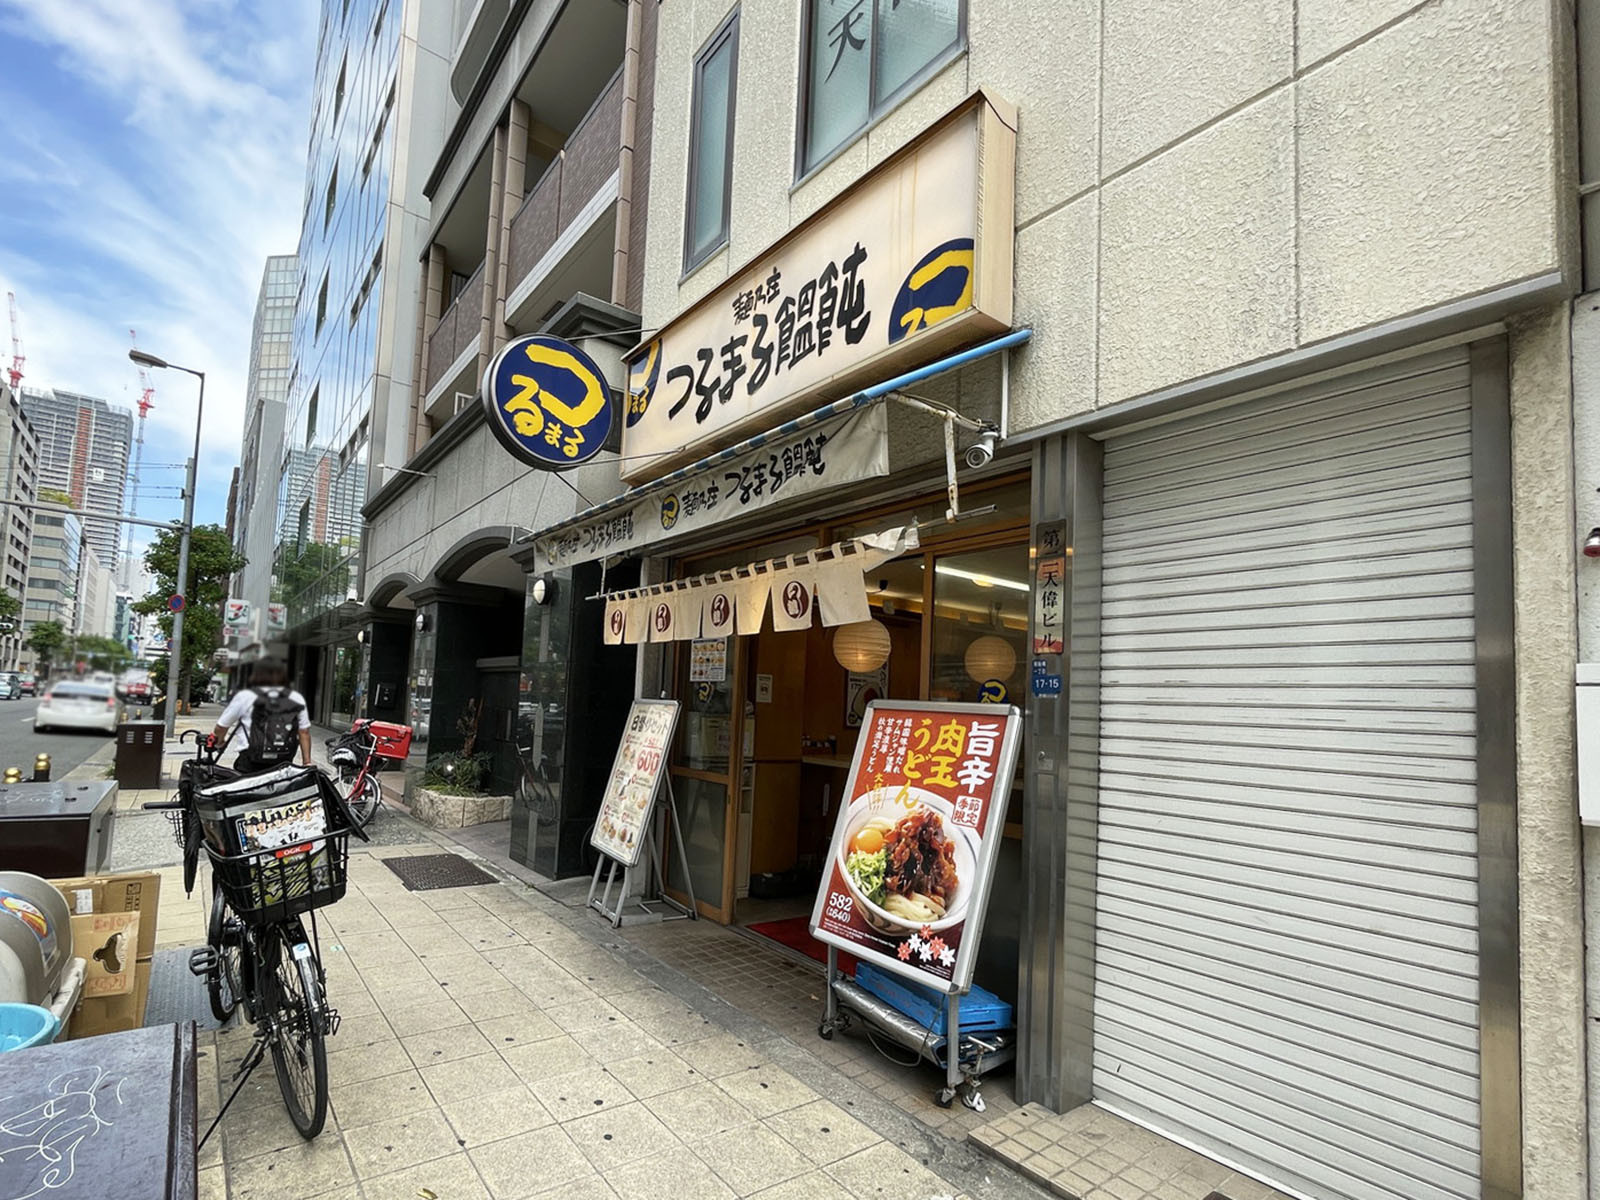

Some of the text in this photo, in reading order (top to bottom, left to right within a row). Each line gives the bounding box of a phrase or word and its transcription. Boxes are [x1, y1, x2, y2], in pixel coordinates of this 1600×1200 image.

[666, 241, 872, 425] つるまる饂飩
[724, 431, 828, 505] つるまる饂飩
[895, 718, 933, 809] うどん
[923, 718, 967, 788] 肉玉
[956, 721, 1000, 794] 旨辛
[829, 892, 853, 912] 582
